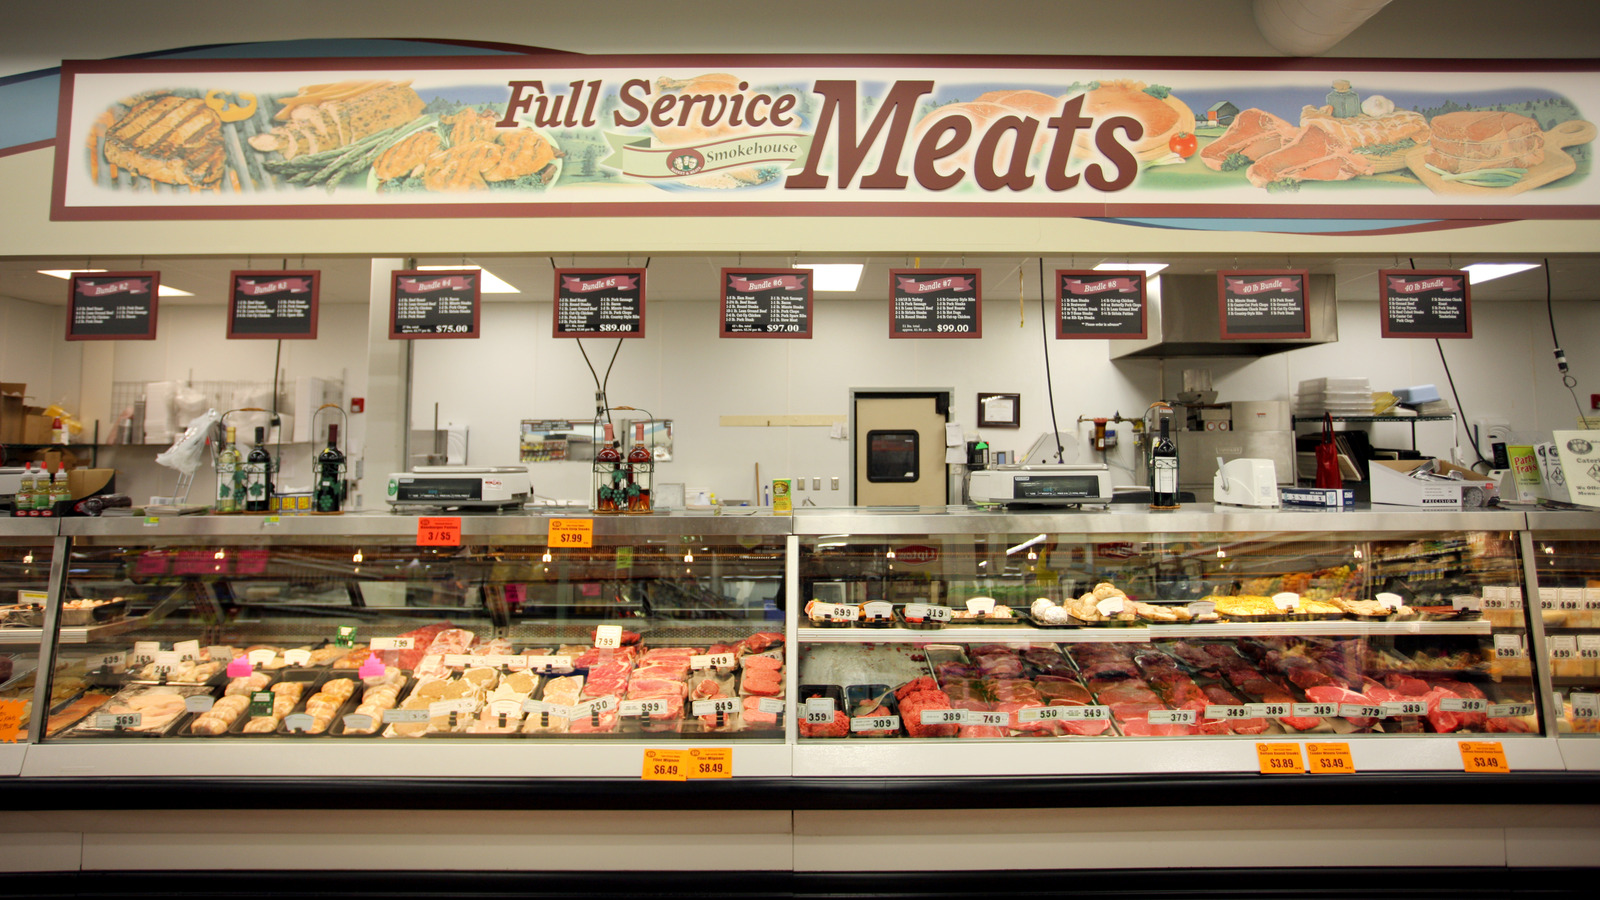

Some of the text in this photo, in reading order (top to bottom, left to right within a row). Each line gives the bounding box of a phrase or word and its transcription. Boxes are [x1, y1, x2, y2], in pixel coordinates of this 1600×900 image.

[495, 78, 1143, 192] Full Service Meats
[706, 142, 798, 163] Smokehouse
[254, 284, 276, 294] Bundle
[418, 281, 440, 291] Bundle
[582, 281, 604, 291] Bundle
[748, 281, 771, 290] Bundle
[918, 281, 941, 291] Bundle
[1084, 283, 1106, 292] Bundle
[1260, 280, 1282, 290] Bundle
[1422, 280, 1444, 289] Bundle
[1514, 454, 1534, 466] Party
[1516, 464, 1537, 474] Trays
[428, 532, 434, 540] 3
[440, 532, 450, 540] $5
[560, 534, 582, 542] $7.99
[1560, 601, 1576, 609] 498
[834, 608, 851, 616] 699
[926, 608, 944, 618] 319
[598, 638, 613, 646] 799
[1498, 648, 1515, 656] 699
[1553, 650, 1570, 658] 499
[1582, 650, 1598, 658] 649
[590, 700, 608, 712] 250
[642, 702, 659, 711] 999
[715, 702, 732, 710] 849
[1266, 706, 1284, 714] 389
[1314, 706, 1331, 714] 349
[1402, 704, 1420, 713] 389
[1462, 702, 1480, 710] 349
[1509, 706, 1527, 714] 379
[808, 712, 826, 721] 359
[943, 712, 961, 721] 389
[1040, 709, 1057, 718] 550
[1084, 708, 1101, 717] 549
[1227, 708, 1244, 716] 349
[1362, 708, 1380, 716] 379
[1574, 708, 1592, 716] 439
[116, 716, 134, 725] 569
[984, 714, 1000, 723] 749
[1170, 713, 1188, 722] 379
[874, 720, 892, 728] 309
[1270, 758, 1294, 768] $3.89
[1320, 758, 1344, 768] $3.49
[1474, 757, 1498, 767] $3.49
[654, 765, 678, 774] $6.49
[699, 764, 722, 773] $8.49
